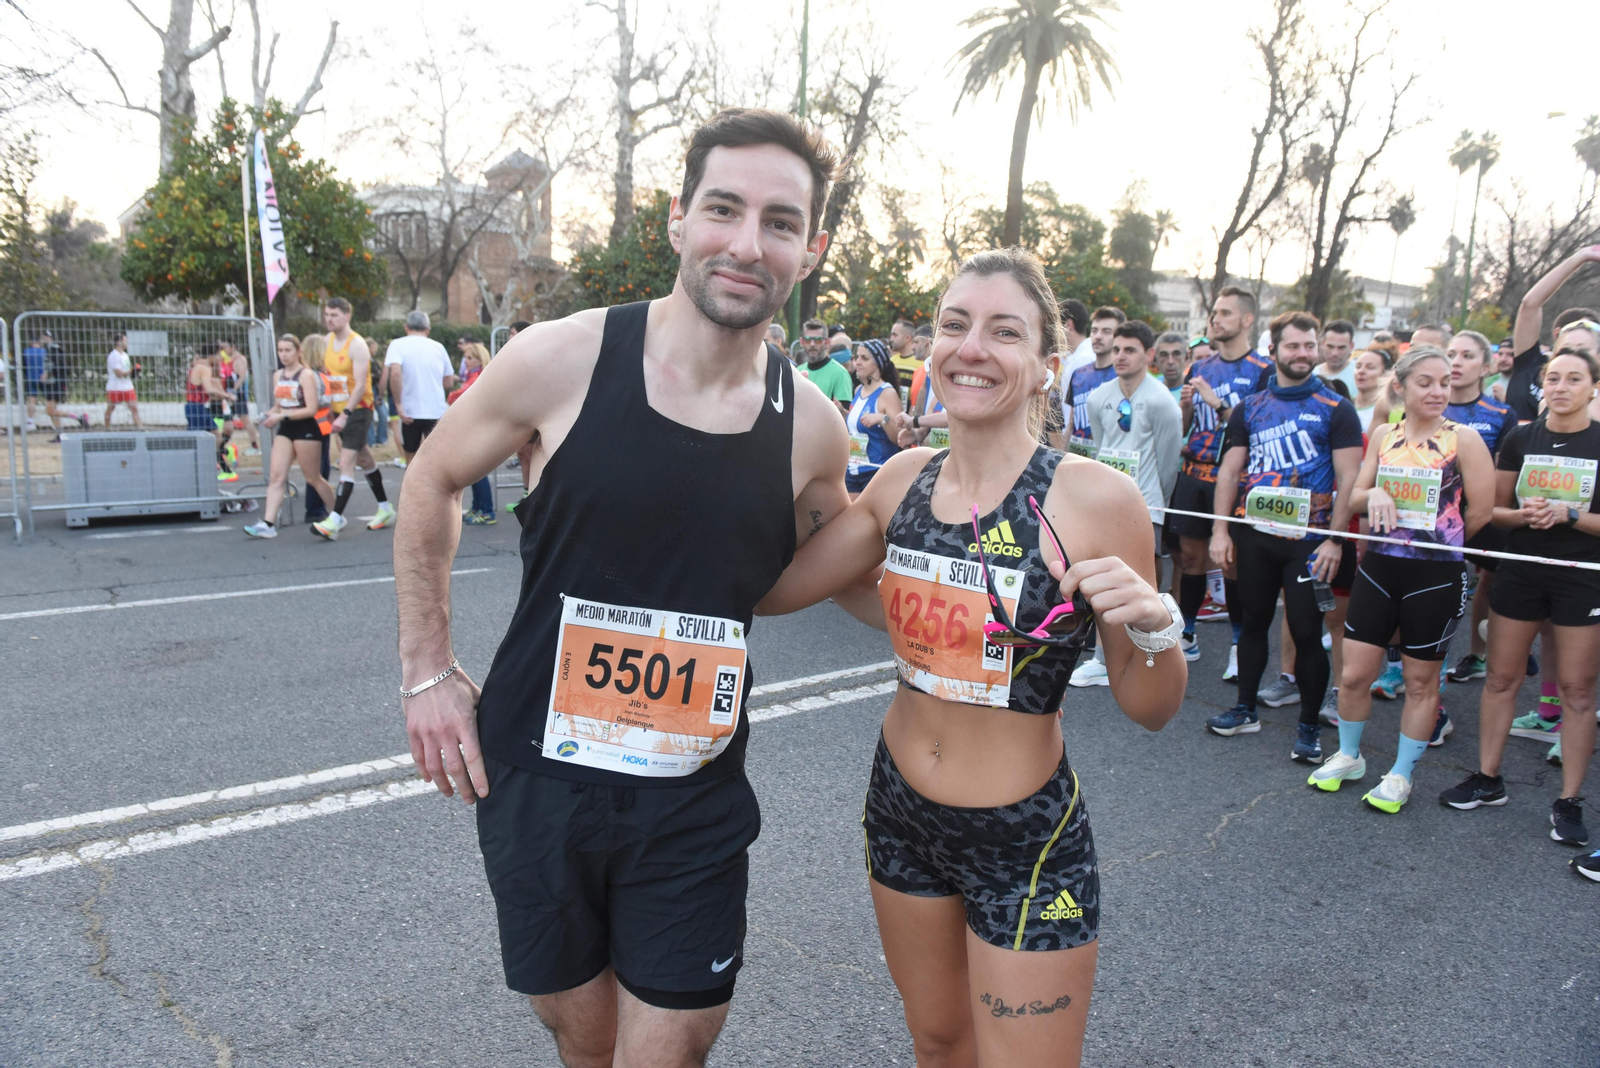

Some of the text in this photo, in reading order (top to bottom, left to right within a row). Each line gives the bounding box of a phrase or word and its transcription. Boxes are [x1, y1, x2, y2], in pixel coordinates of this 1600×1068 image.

[1299, 413, 1322, 423] HOKA
[1527, 469, 1575, 492] 6880
[1383, 480, 1422, 502] 6380
[1256, 496, 1294, 516] 6490
[968, 540, 1023, 558] adidas
[897, 552, 931, 573] MARATÓN
[1456, 571, 1469, 618] WONG
[575, 603, 726, 643] MEDIO MARATÓN SEVILLA
[888, 587, 970, 650] 4256
[915, 642, 935, 656] DUB'S
[562, 658, 571, 681] CAJÓN
[584, 642, 697, 705] 5501
[628, 699, 649, 710] Jib's
[616, 715, 655, 730] Delplanque
[621, 753, 648, 767] HOKA
[1040, 907, 1083, 920] adidas
